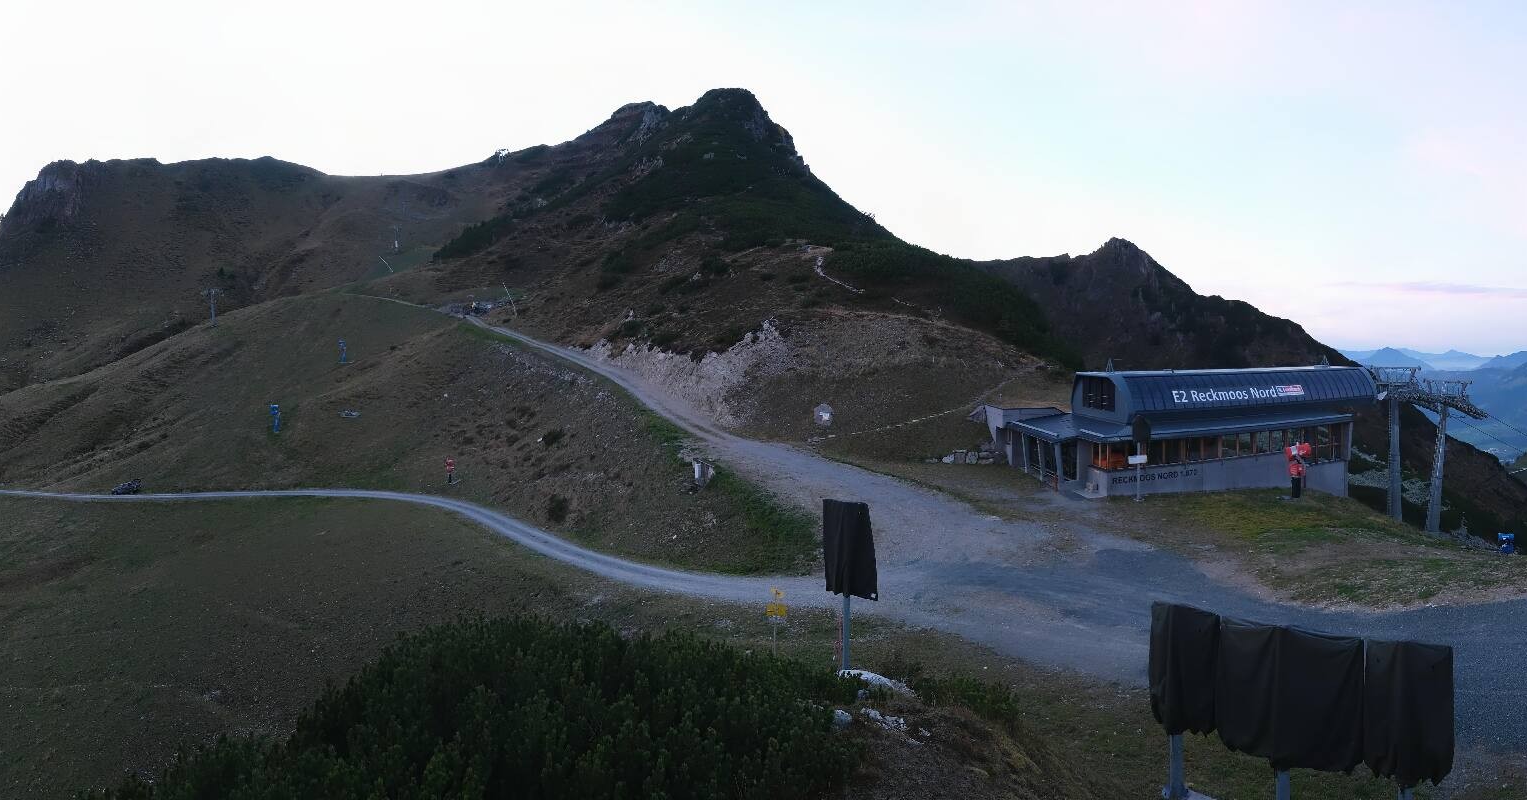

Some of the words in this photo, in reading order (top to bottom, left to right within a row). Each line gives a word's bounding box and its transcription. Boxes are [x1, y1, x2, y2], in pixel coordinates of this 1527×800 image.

[1172, 390, 1189, 403] E2
[1191, 388, 1248, 402] Reckmoos
[1250, 386, 1277, 399] Nord
[1157, 471, 1178, 480] NORD
